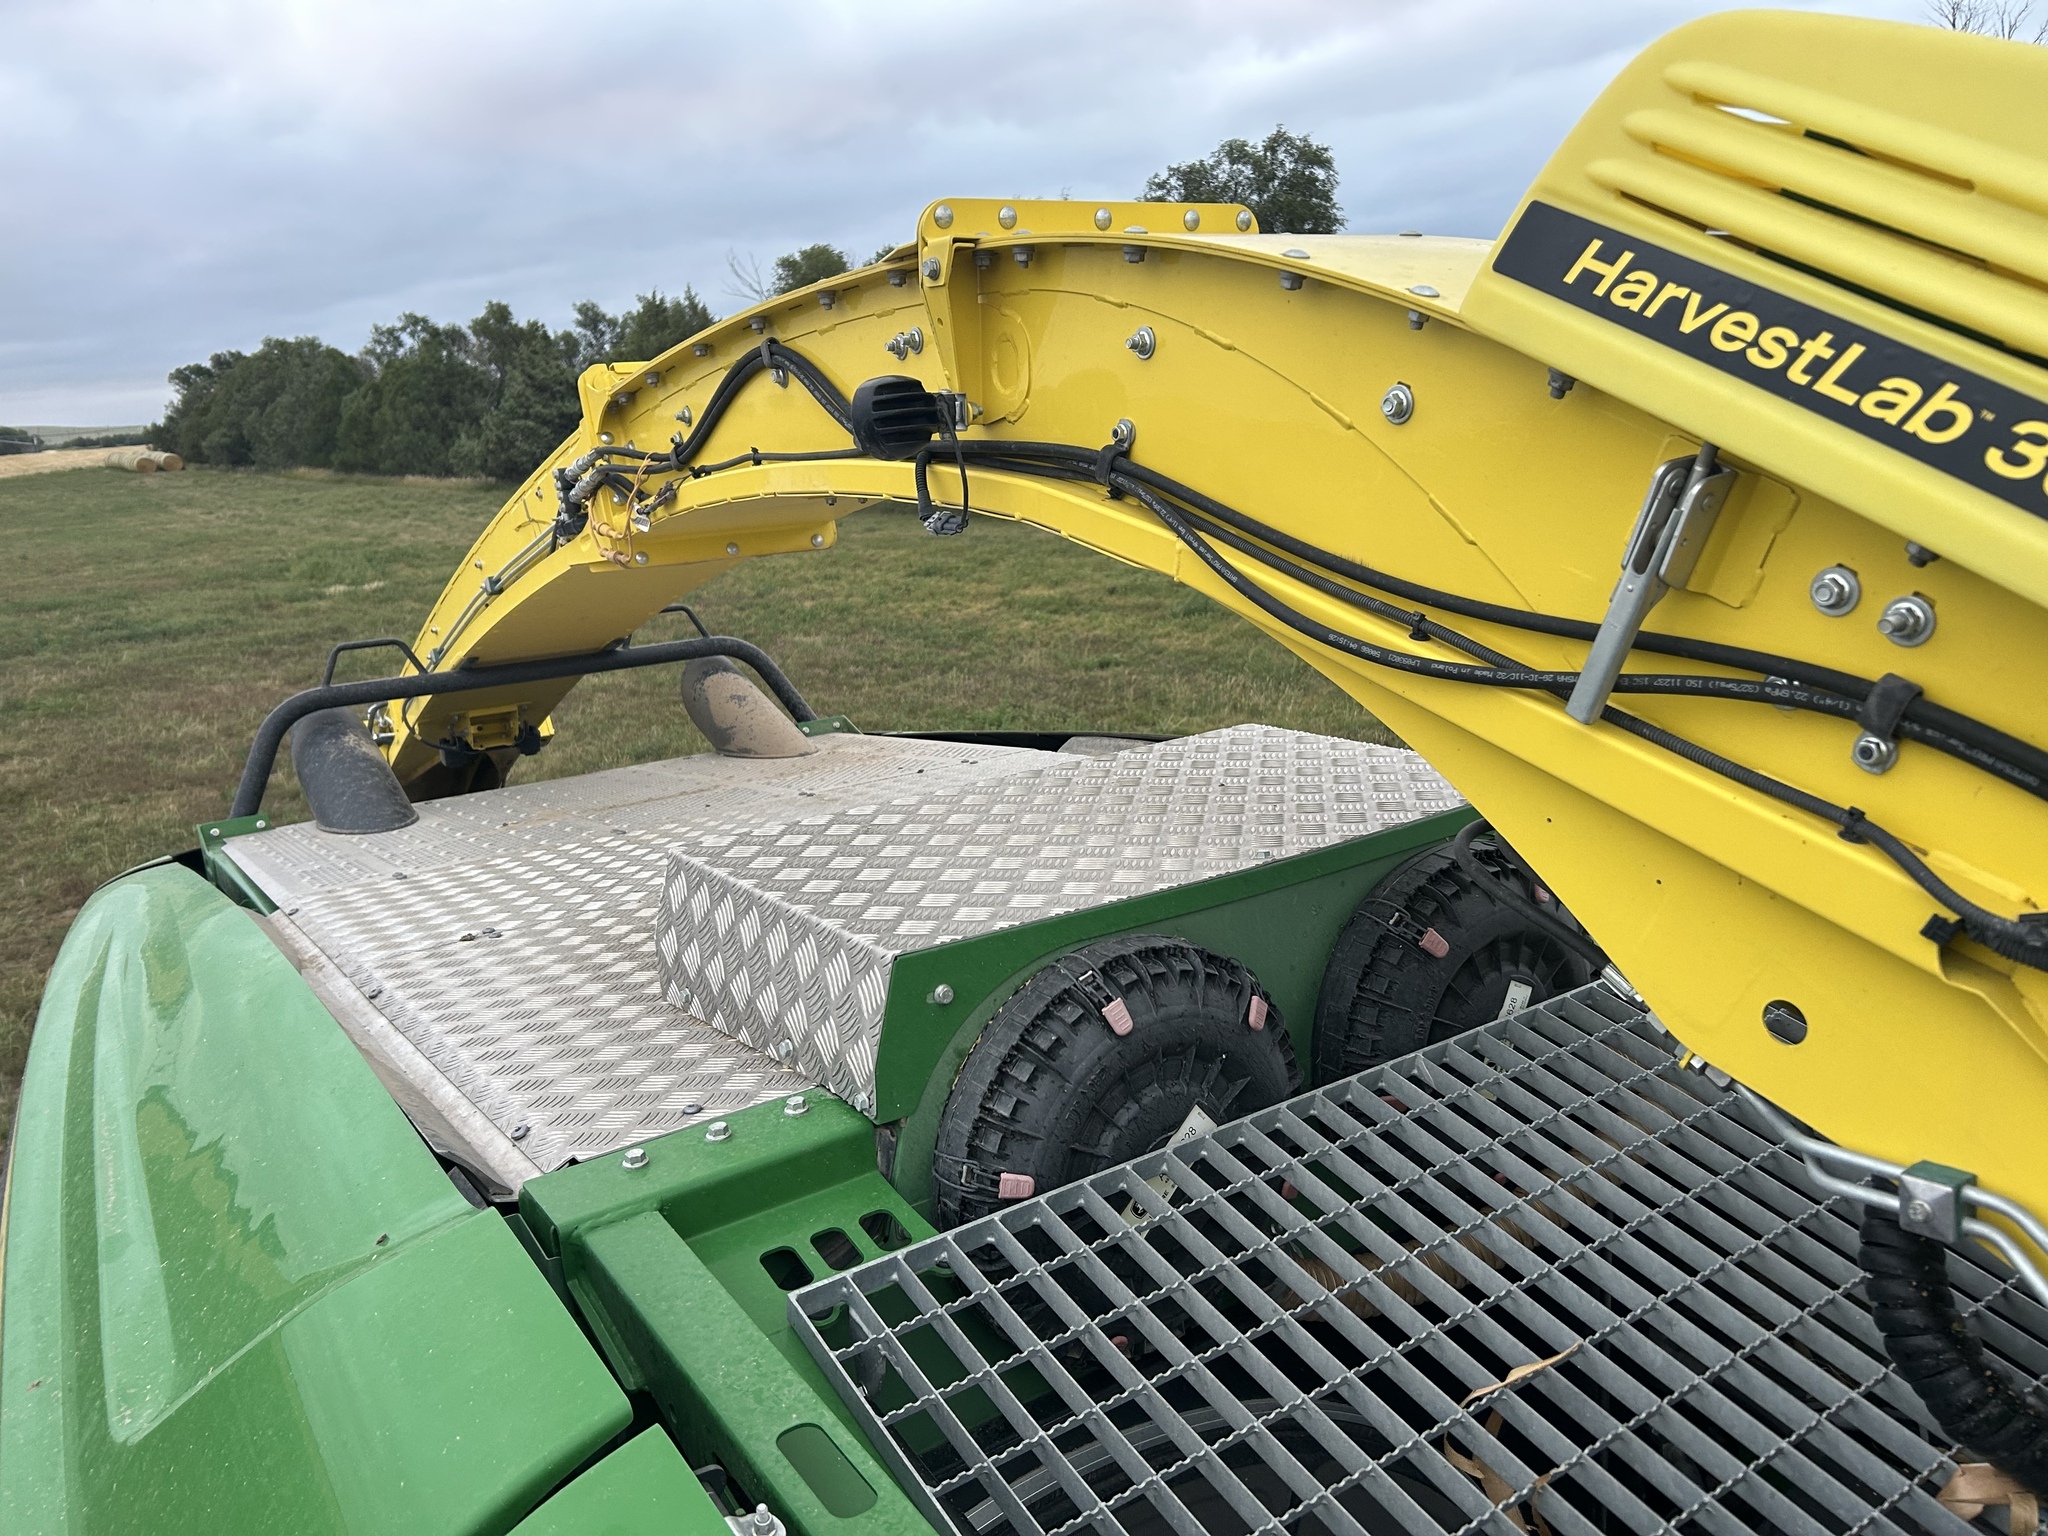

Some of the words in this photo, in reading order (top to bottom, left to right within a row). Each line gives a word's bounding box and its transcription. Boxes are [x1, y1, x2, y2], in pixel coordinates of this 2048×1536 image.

[1984, 420, 2048, 497] 3
[1198, 546, 1213, 560] Series
[1430, 663, 1458, 674] Poland
[1461, 668, 1470, 677] in
[1474, 670, 1493, 678] Made
[1654, 678, 1681, 686] 11237
[1686, 679, 1702, 688] ISO
[1708, 681, 1760, 692] (3275psi)
[1506, 997, 1518, 1017] 628
